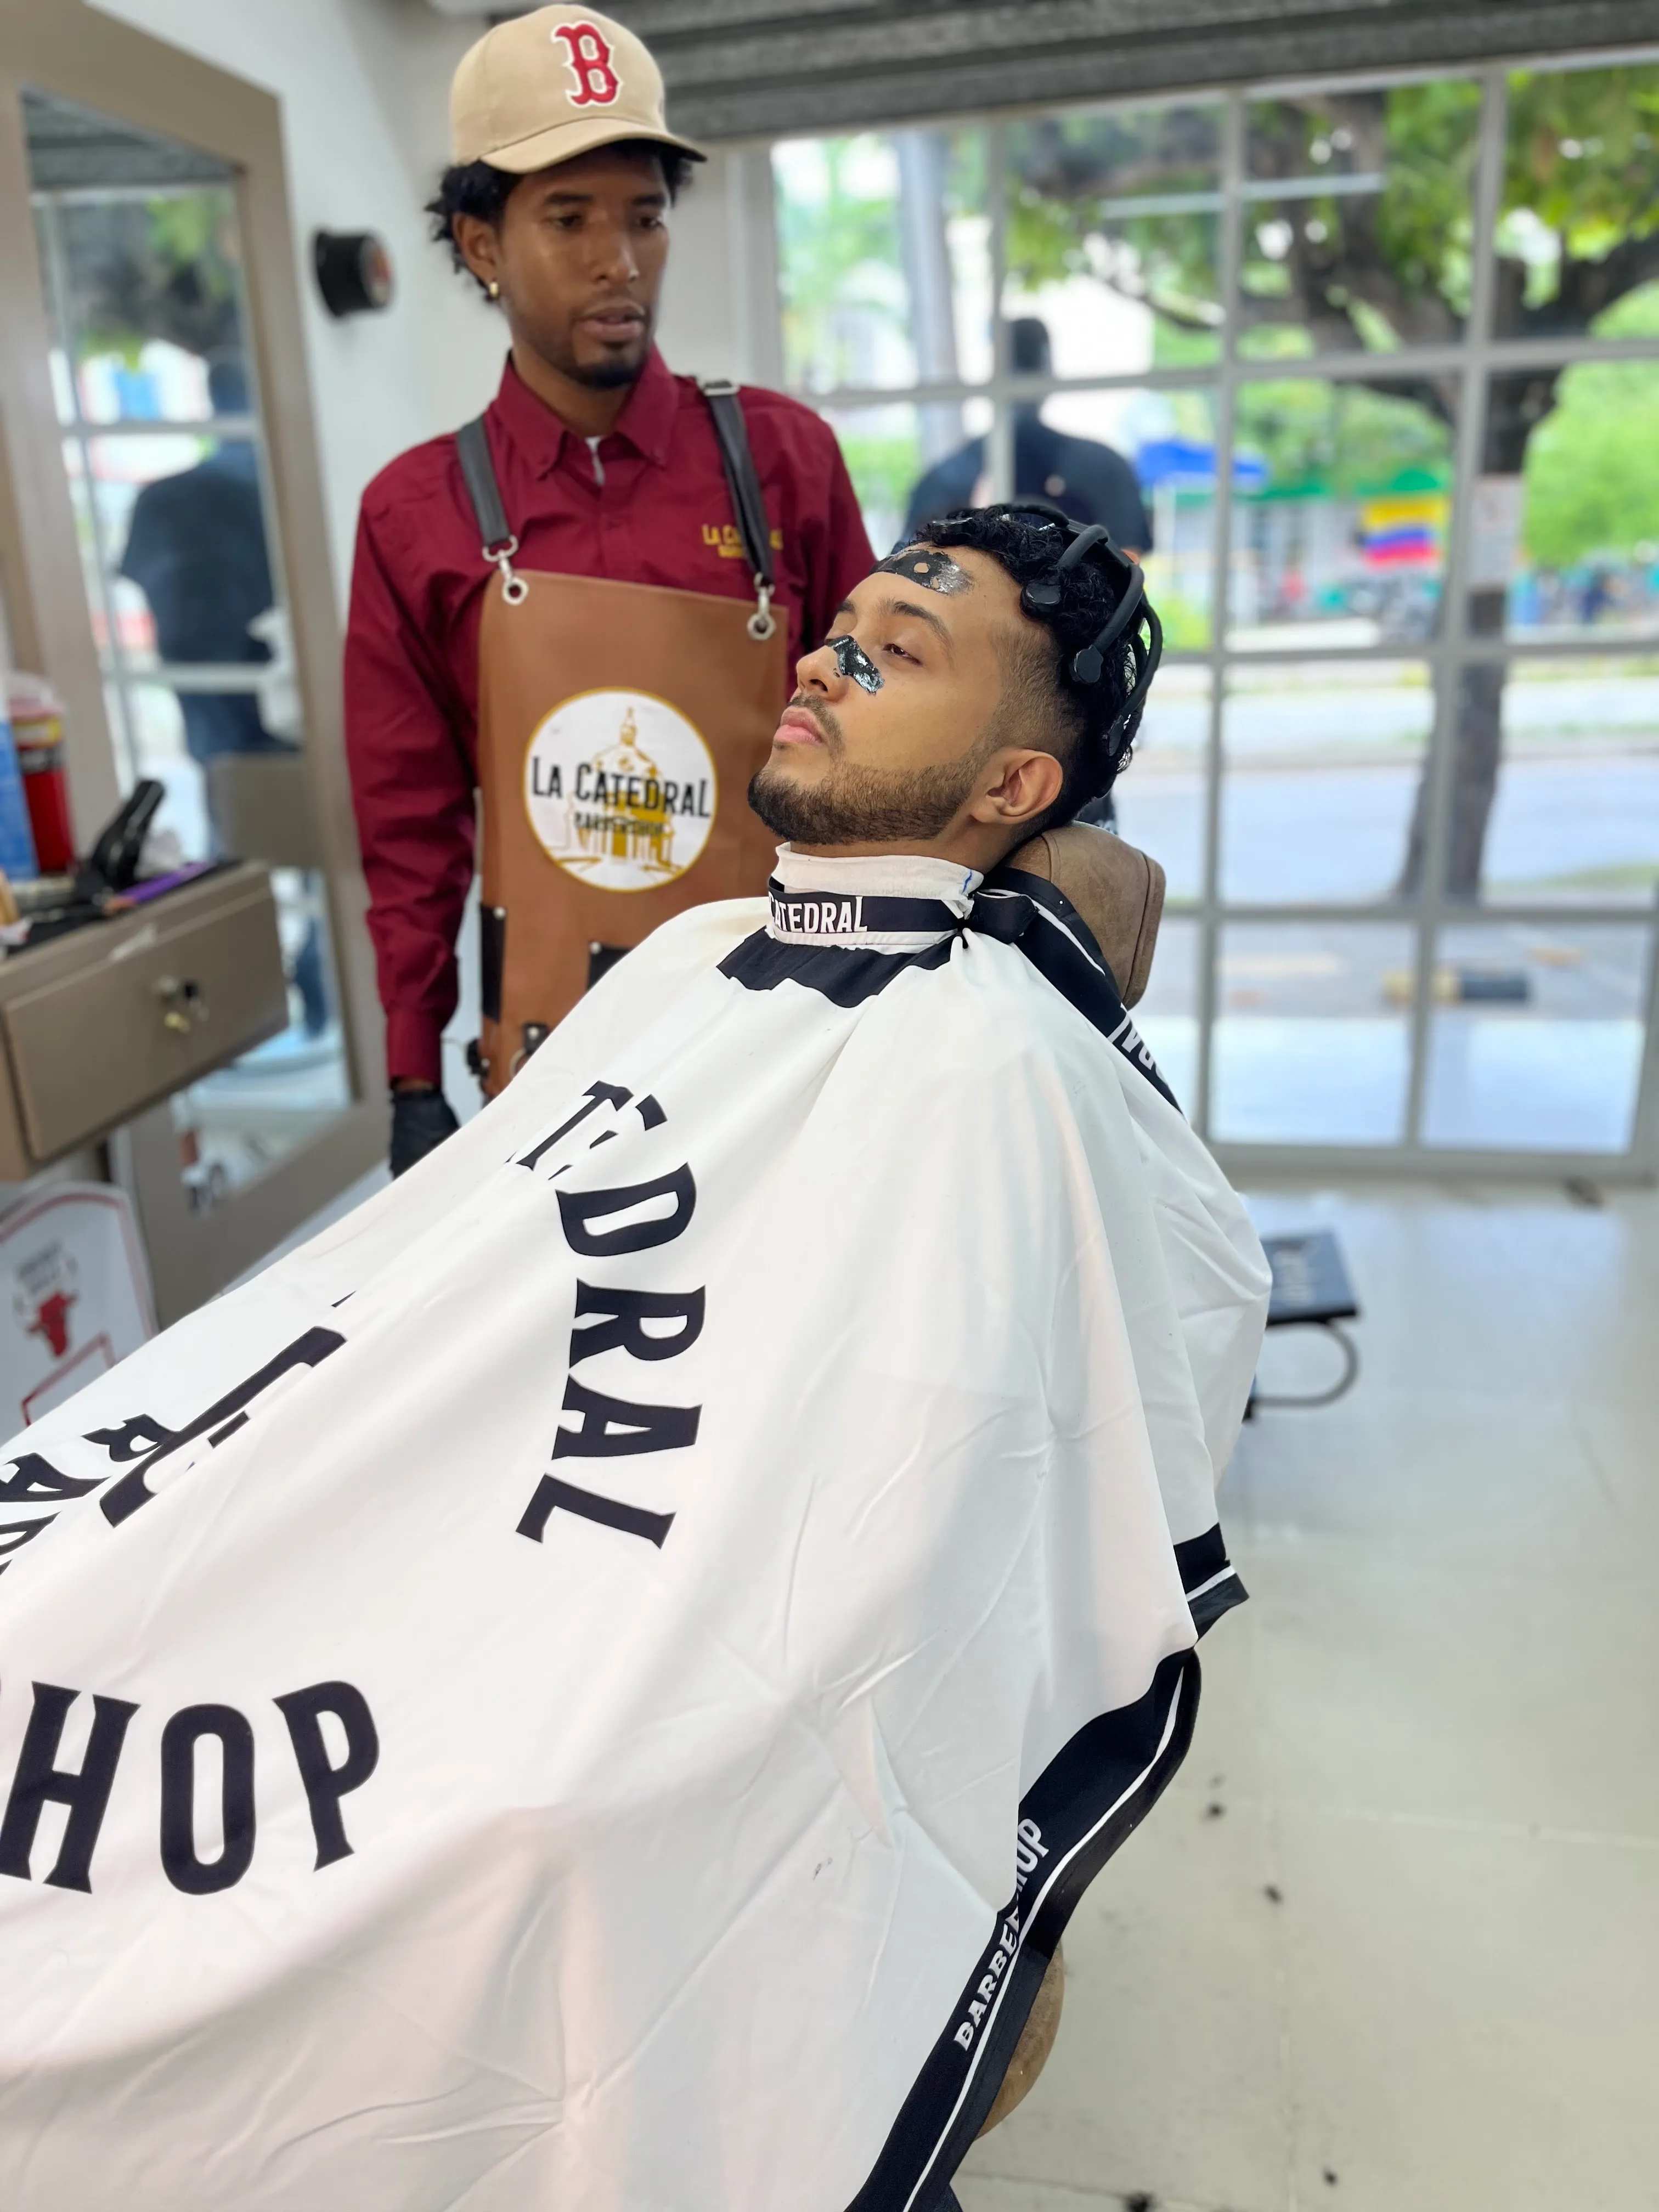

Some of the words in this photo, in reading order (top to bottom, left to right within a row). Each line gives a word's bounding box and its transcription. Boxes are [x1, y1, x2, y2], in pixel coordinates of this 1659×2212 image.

[551, 21, 623, 107] B
[532, 755, 563, 800] LA
[574, 763, 710, 819] CATEDRAL
